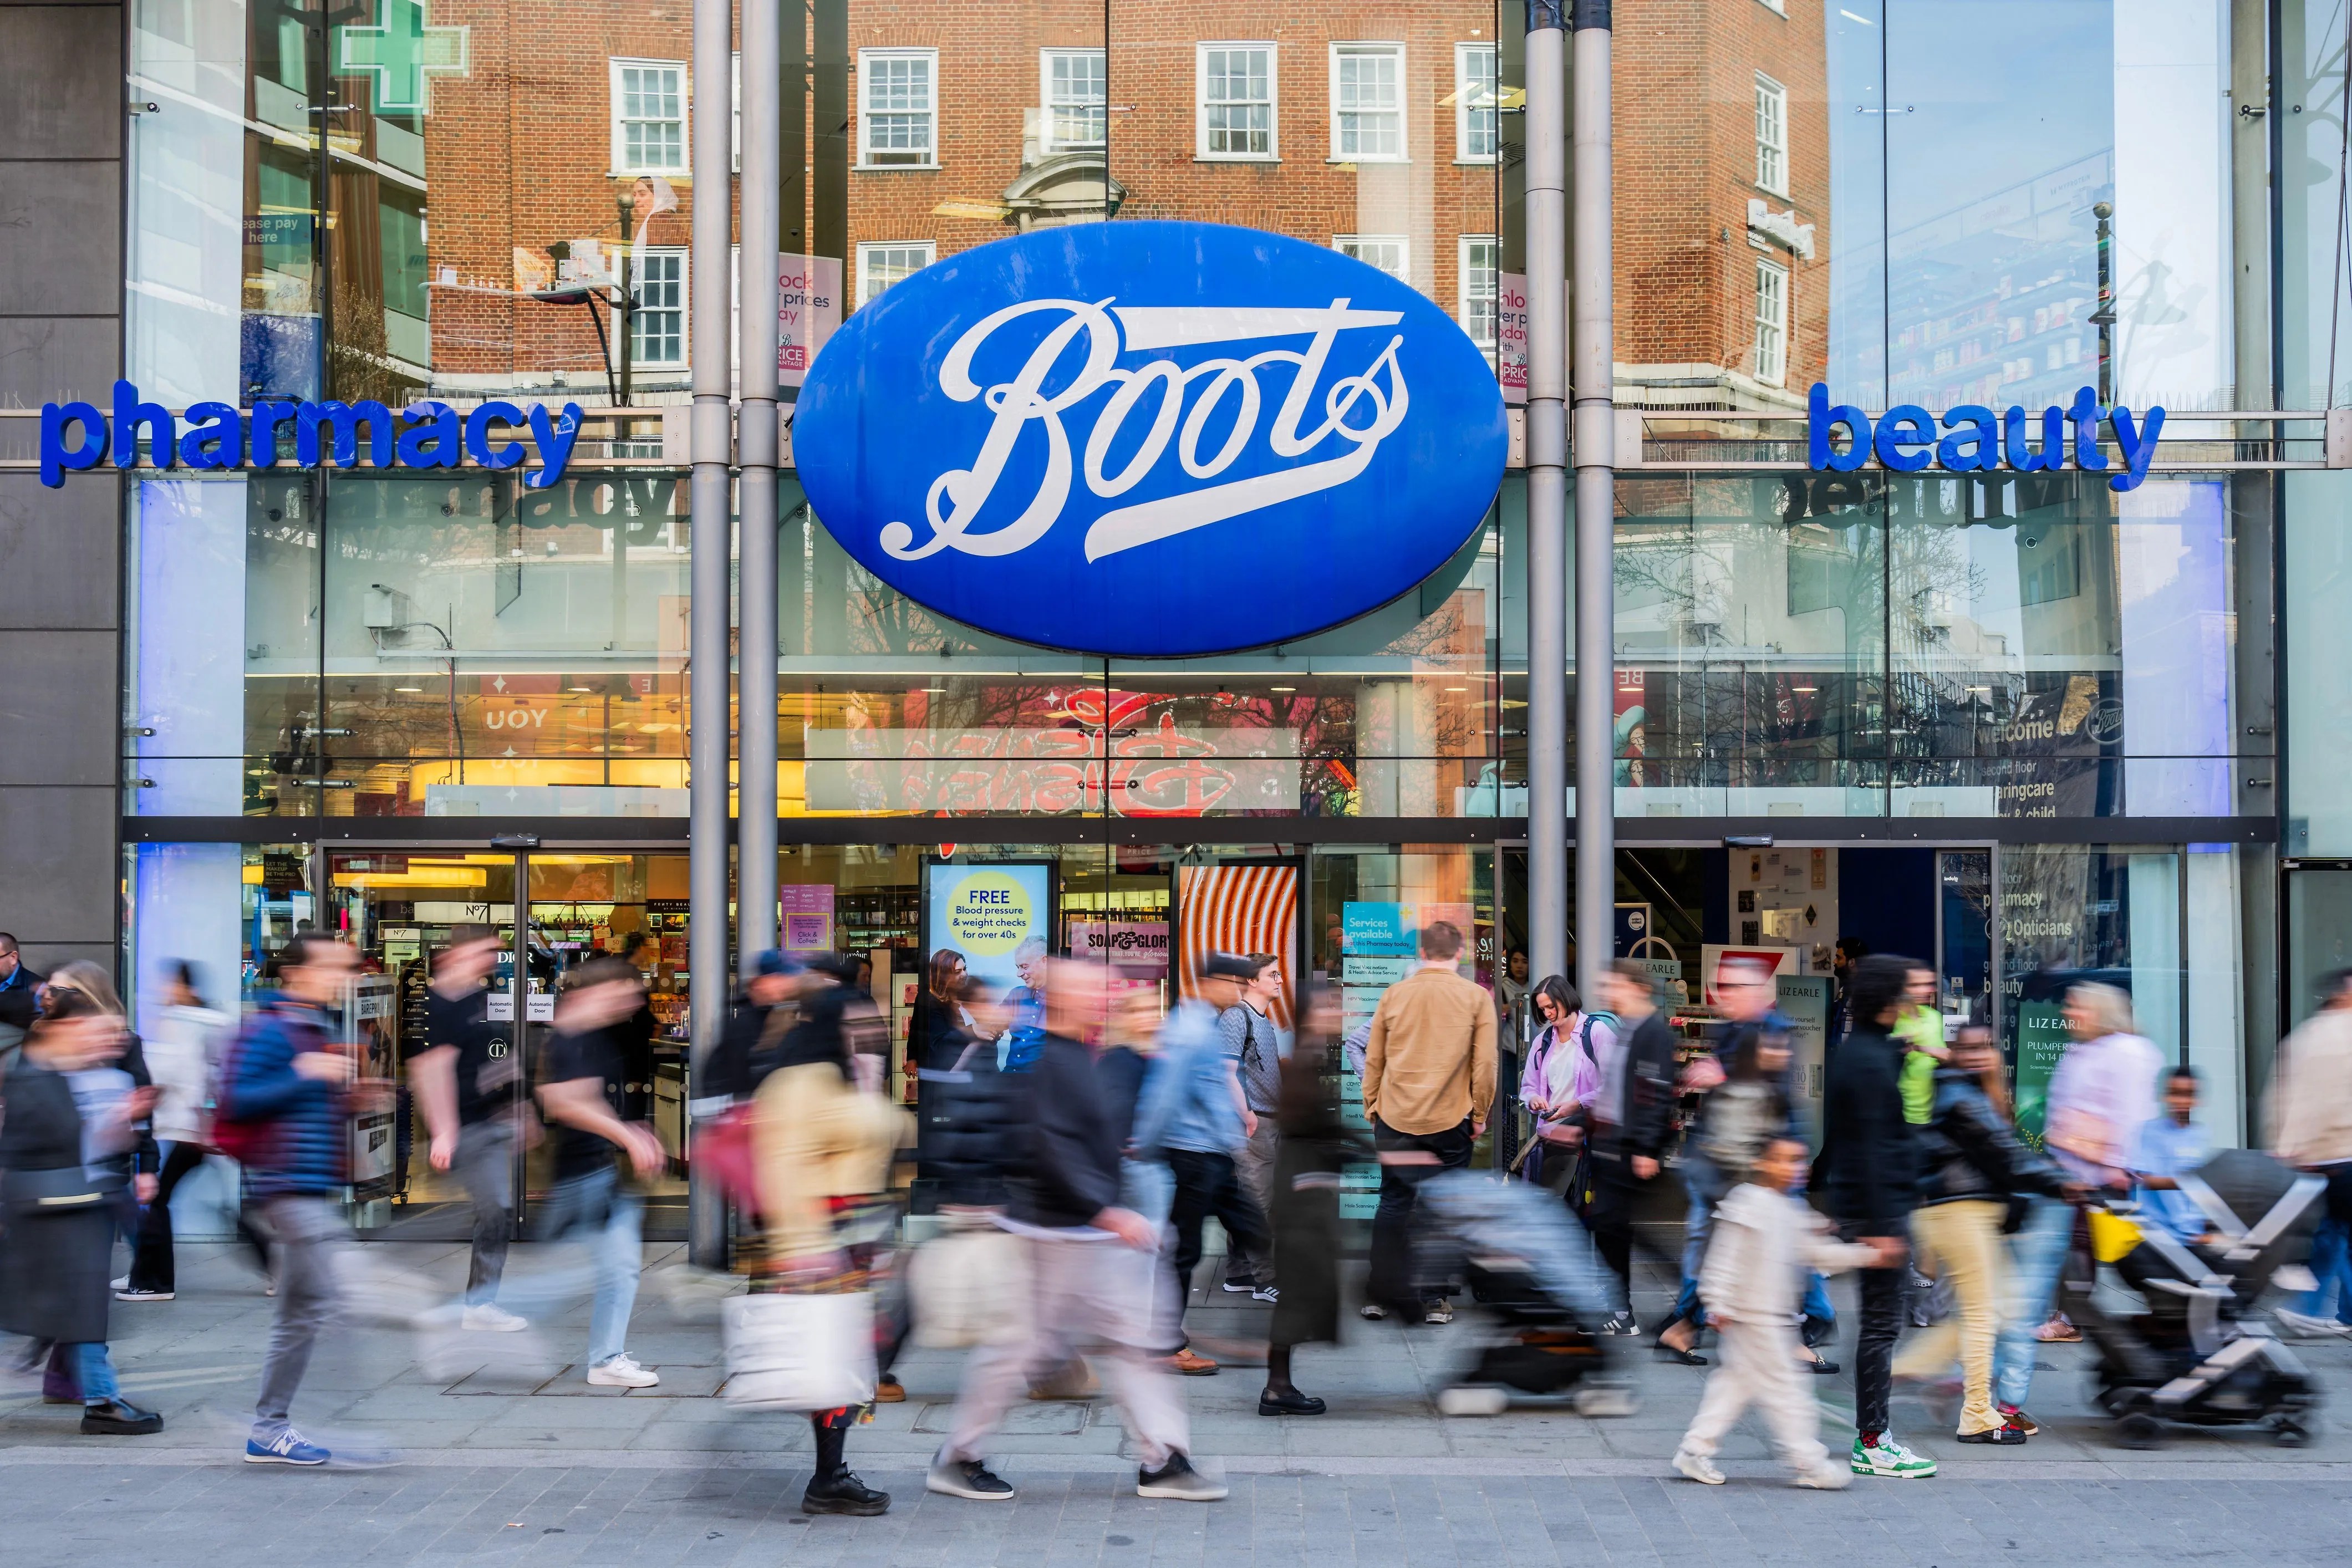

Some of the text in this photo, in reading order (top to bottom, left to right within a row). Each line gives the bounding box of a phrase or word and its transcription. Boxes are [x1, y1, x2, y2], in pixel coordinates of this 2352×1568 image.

[243, 219, 298, 231] ease pay
[249, 231, 277, 243] here
[778, 272, 813, 290] ock
[784, 291, 829, 308] prices
[1501, 342, 1514, 352] ith
[1503, 365, 1526, 380] PRIC
[40, 379, 584, 488] pharmacy
[880, 296, 1408, 564] Boots
[1809, 382, 2166, 492] beauty
[1979, 719, 2054, 744] welcome
[1982, 761, 2037, 777] second floor
[1998, 782, 2055, 802] aringcare
[970, 890, 1010, 904] FREE
[1984, 891, 2042, 910] parmacy
[956, 905, 1024, 917] Blood pressure
[961, 918, 993, 929] weight
[1349, 918, 1388, 927] Services
[2014, 918, 2072, 939] Opticians
[963, 930, 975, 938] for
[1000, 930, 1016, 938] 40s
[1117, 931, 1139, 950] &
[1349, 929, 1393, 939] available
[497, 952, 534, 963] DIR
[1143, 949, 1169, 959] gloriou
[1646, 964, 1675, 974] EARLE
[2018, 958, 2039, 971] floor
[1779, 987, 1820, 997] LIZ EARLE
[1984, 976, 2023, 997] bauty
[1795, 1016, 1815, 1025] yourself
[1984, 1011, 2007, 1024] loer
[2029, 1017, 2081, 1030] LIZ EARL
[2028, 1041, 2068, 1051] PLUMPER
[2036, 1052, 2045, 1061] IN
[2047, 1052, 2056, 1061] 14
